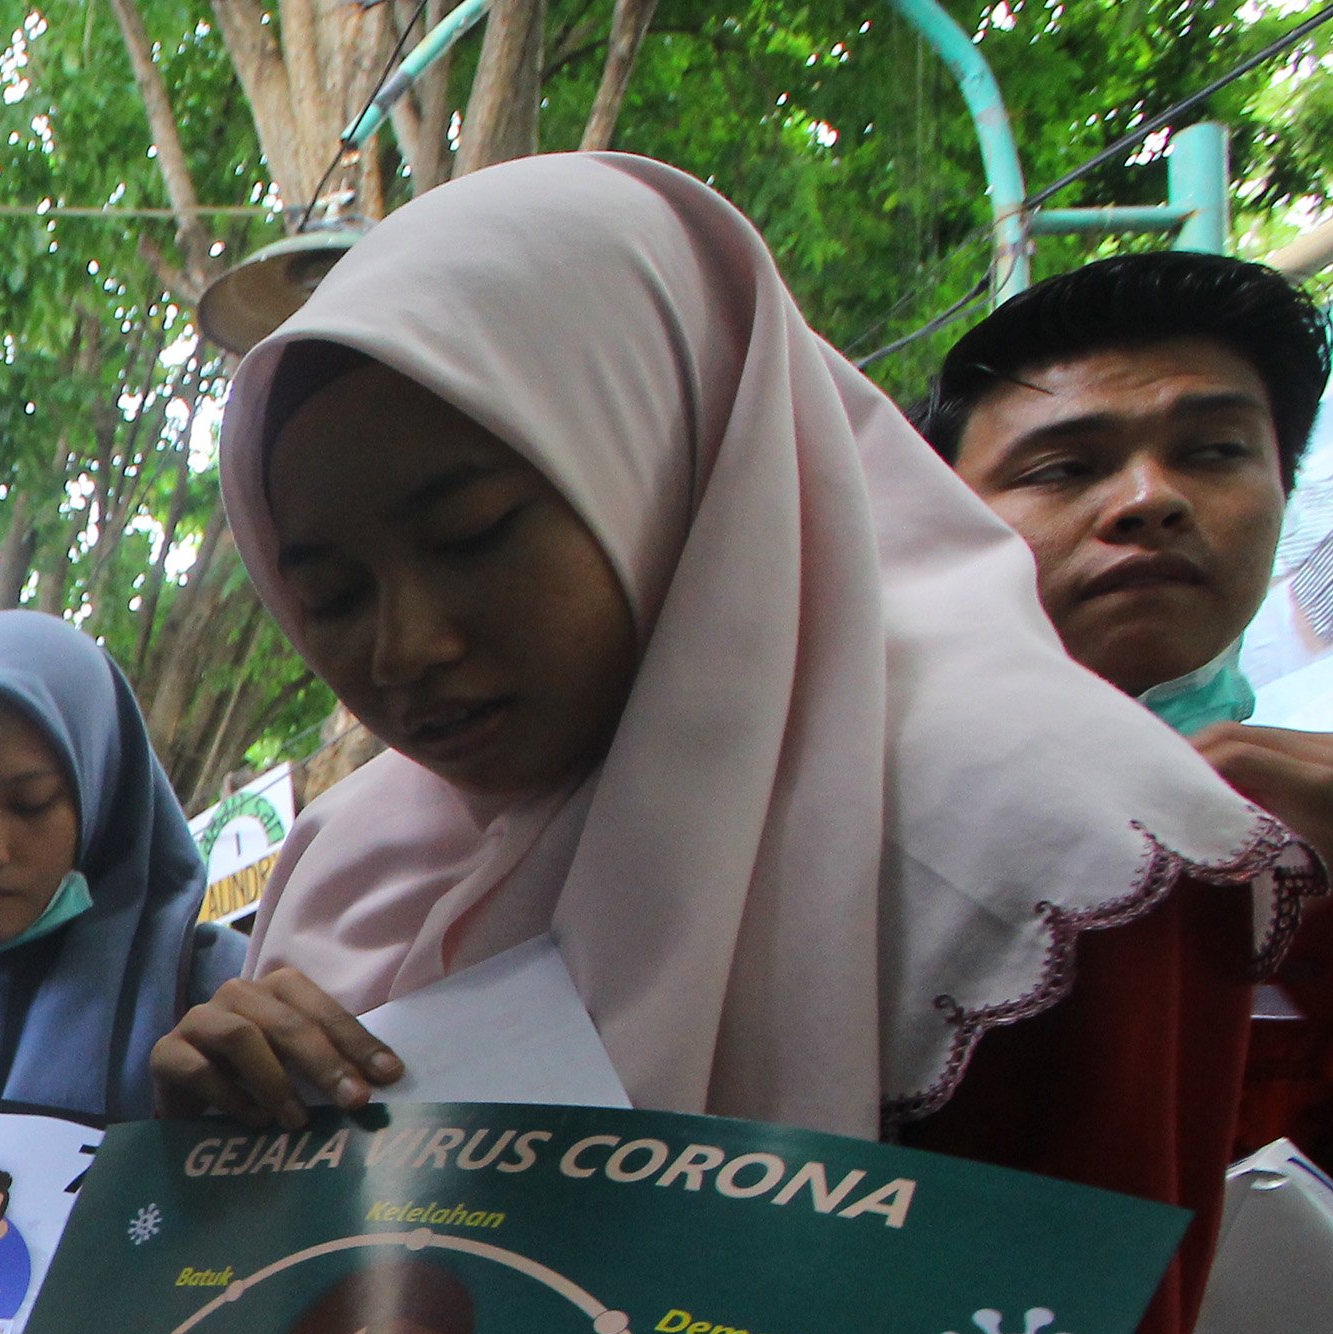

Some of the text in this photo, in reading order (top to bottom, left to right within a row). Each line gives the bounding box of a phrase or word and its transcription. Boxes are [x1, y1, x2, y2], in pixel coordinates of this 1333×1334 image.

[183, 1127, 918, 1229] GEJALA VIRUS CORONA
[364, 1200, 507, 1229] Kelelahan
[175, 1267, 236, 1288] Batuk
